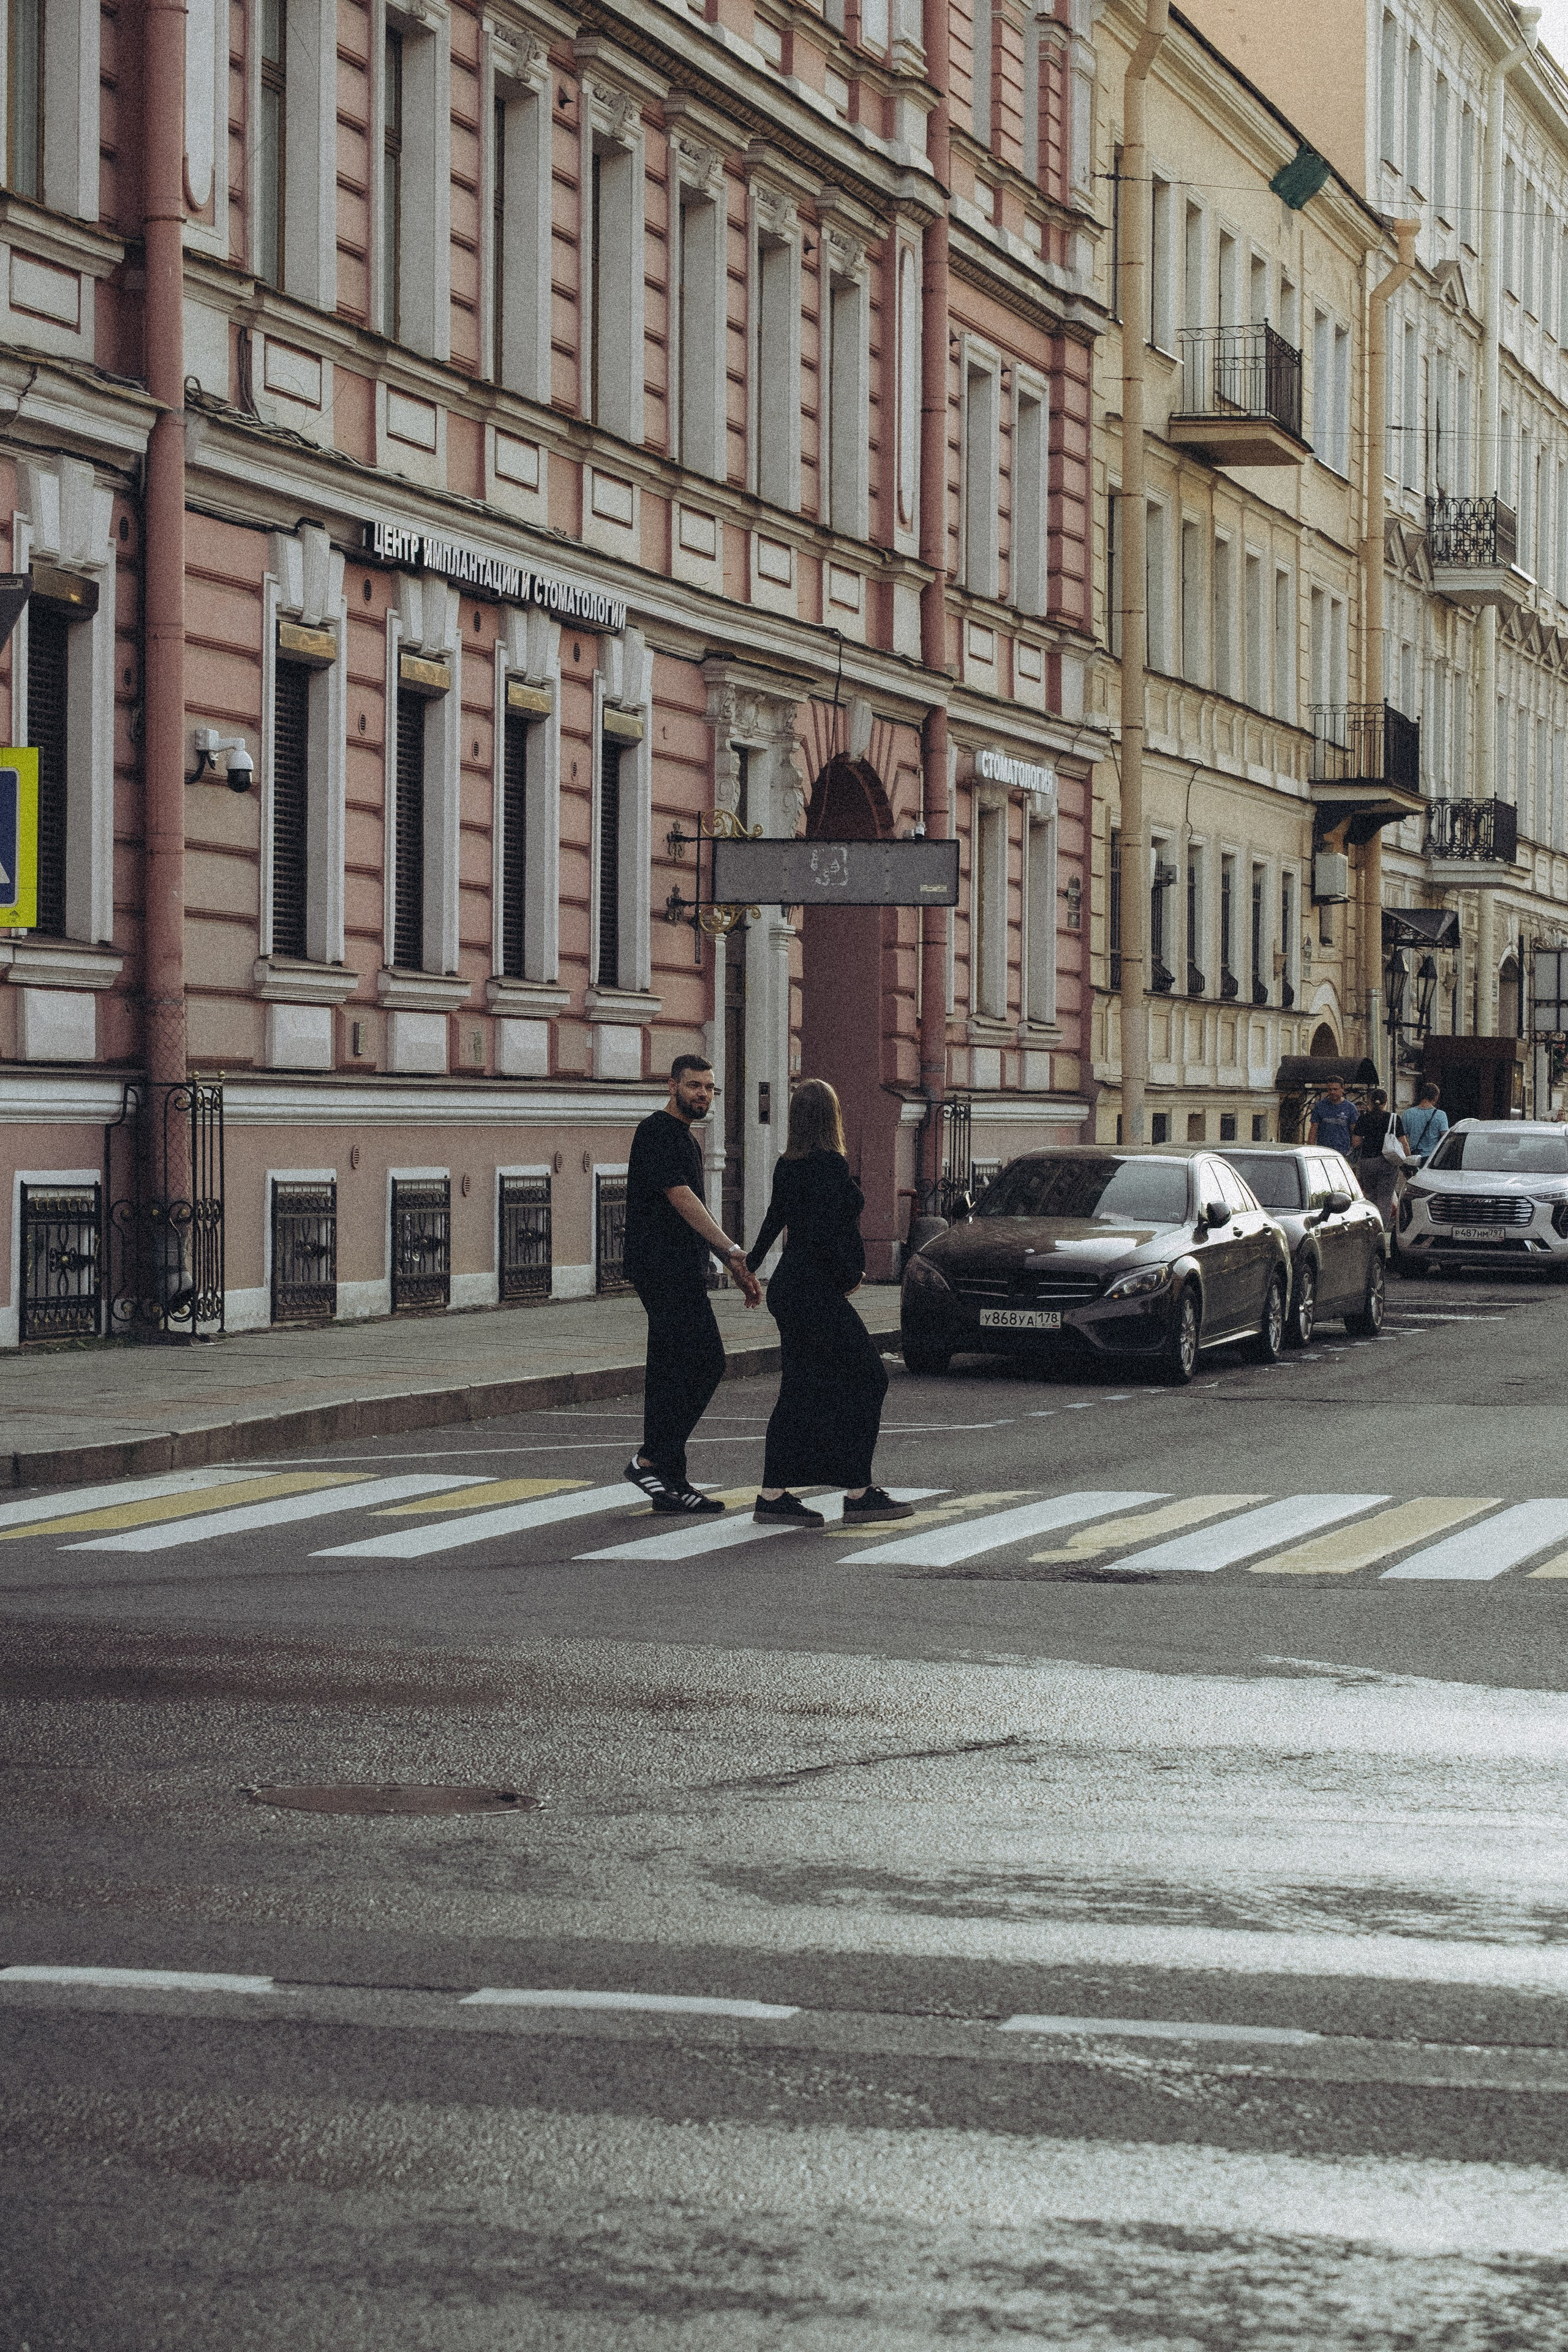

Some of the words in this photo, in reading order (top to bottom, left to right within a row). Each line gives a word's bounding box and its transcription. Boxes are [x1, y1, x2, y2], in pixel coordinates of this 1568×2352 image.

[374, 522, 420, 564] ЦЕНТР
[423, 537, 519, 597] ИМПЛАНТАЦИИ
[521, 570, 531, 600] И
[534, 575, 627, 630] СТОМАТОЛОГИИ
[982, 750, 1053, 795] СТОМАТОЛОГИЯ
[984, 1311, 1034, 1326] У868УА
[1038, 1313, 1058, 1323] 178
